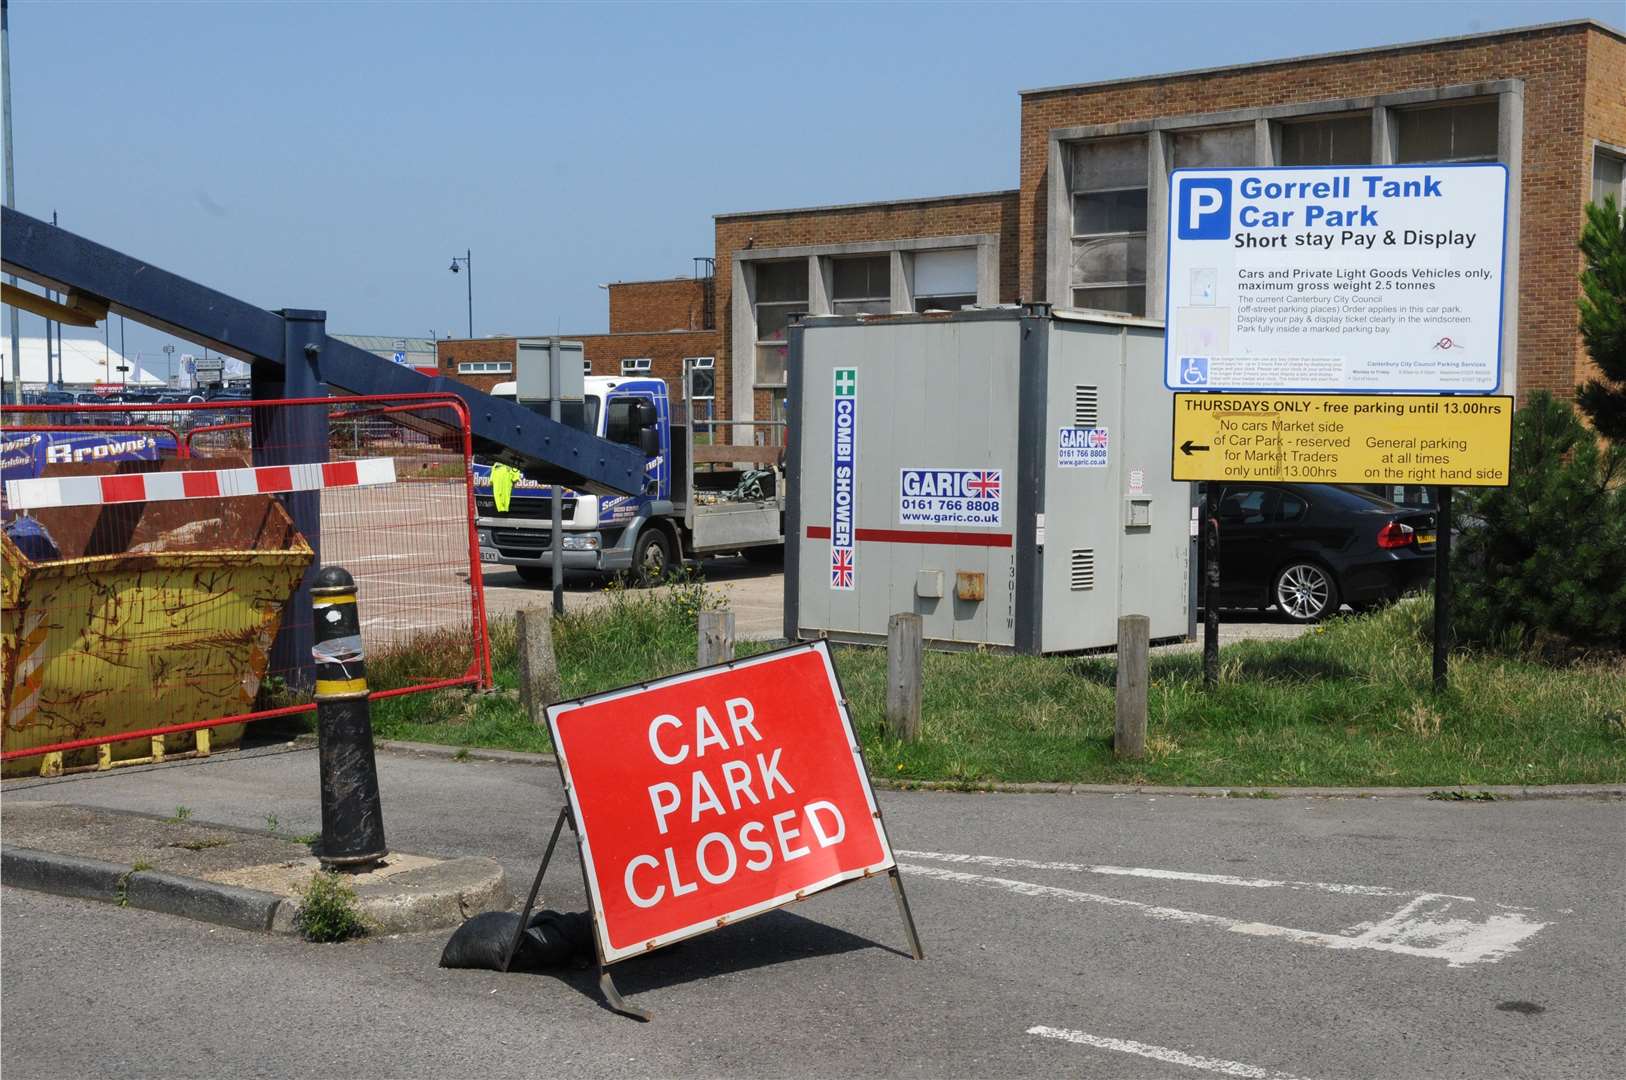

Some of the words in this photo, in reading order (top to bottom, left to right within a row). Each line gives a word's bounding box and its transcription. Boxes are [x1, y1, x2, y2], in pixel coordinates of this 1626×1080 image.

[1240, 175, 1350, 199] Gorrell
[1362, 175, 1442, 198] Tank
[1189, 187, 1223, 230] P
[1240, 205, 1295, 227] Car
[1305, 204, 1378, 227] Park
[1234, 232, 1287, 248] Short
[1295, 231, 1334, 250] stay
[1341, 230, 1376, 250] Pay
[1383, 230, 1396, 245] &
[1404, 229, 1477, 249] Display
[1238, 268, 1265, 279] Cars
[1268, 268, 1289, 279] and
[1293, 268, 1333, 279] Private
[1336, 268, 1366, 281] Light
[1369, 268, 1408, 279] Goods
[1412, 267, 1461, 279] Vehicles
[1464, 268, 1493, 281] only,
[1238, 280, 1294, 290] maximum
[1297, 282, 1330, 292] gross
[1333, 280, 1372, 292] weight
[1375, 280, 1392, 290] 2.5
[1396, 280, 1436, 290] tonnes
[1239, 295, 1254, 304] The
[1255, 295, 1284, 304] current
[1286, 295, 1331, 306] Canterbury
[1333, 295, 1349, 306] City
[1351, 295, 1383, 304] Council
[1278, 305, 1308, 315] parking
[1310, 305, 1340, 315] places)
[1342, 305, 1365, 313] Order
[1368, 305, 1397, 315] applies
[1399, 305, 1407, 313] in
[1409, 305, 1424, 313] this
[1237, 315, 1266, 324] Display
[1269, 316, 1286, 324] your
[1289, 316, 1304, 324] pay
[1314, 315, 1342, 324] display
[1345, 315, 1367, 323] ticket
[1369, 315, 1396, 324] clearly
[1398, 315, 1406, 323] in
[1407, 315, 1421, 323] the
[1237, 325, 1256, 333] Park
[1258, 325, 1274, 334] fully
[1276, 325, 1300, 333] inside
[1309, 325, 1340, 333] marked
[1342, 325, 1373, 335] parking
[1184, 399, 1270, 412] THURSDAYS
[1273, 400, 1311, 413] ONLY
[1323, 401, 1349, 413] free
[1353, 402, 1404, 416] parking
[1408, 402, 1439, 414] until
[1443, 402, 1502, 415] 13.00hrs
[837, 399, 853, 462] COMBI
[1220, 419, 1238, 432] No
[1241, 421, 1268, 432] cars
[1271, 420, 1314, 433] Market
[1318, 421, 1344, 433] side
[1060, 430, 1098, 448] GARIC
[1213, 434, 1227, 446] of
[1229, 435, 1252, 447] Car
[1255, 435, 1284, 447] Park
[1296, 436, 1350, 448] reserved
[1365, 436, 1417, 449] General
[1420, 437, 1467, 453] parking
[1224, 449, 1241, 461] for
[1244, 450, 1287, 462] Market
[1291, 450, 1338, 463] Traders
[1381, 453, 1394, 464] at
[1397, 452, 1412, 464] all
[1415, 453, 1450, 465] times
[1224, 465, 1250, 479] only
[1254, 465, 1279, 477] until
[1284, 466, 1337, 478] 13.00hrs
[1364, 469, 1380, 478] on
[1384, 467, 1404, 479] the
[1408, 467, 1436, 482] right
[1440, 467, 1472, 479] hand
[1476, 468, 1503, 480] side
[903, 471, 983, 497] GARIC
[835, 466, 851, 546] SHOWER
[902, 499, 932, 510] 0161
[938, 500, 962, 511] 766
[966, 500, 1000, 512] 8808
[902, 513, 999, 523] www.garic.co.uk
[648, 696, 764, 766] CAR
[648, 748, 795, 834] PARK
[623, 800, 846, 908] CLOSED
